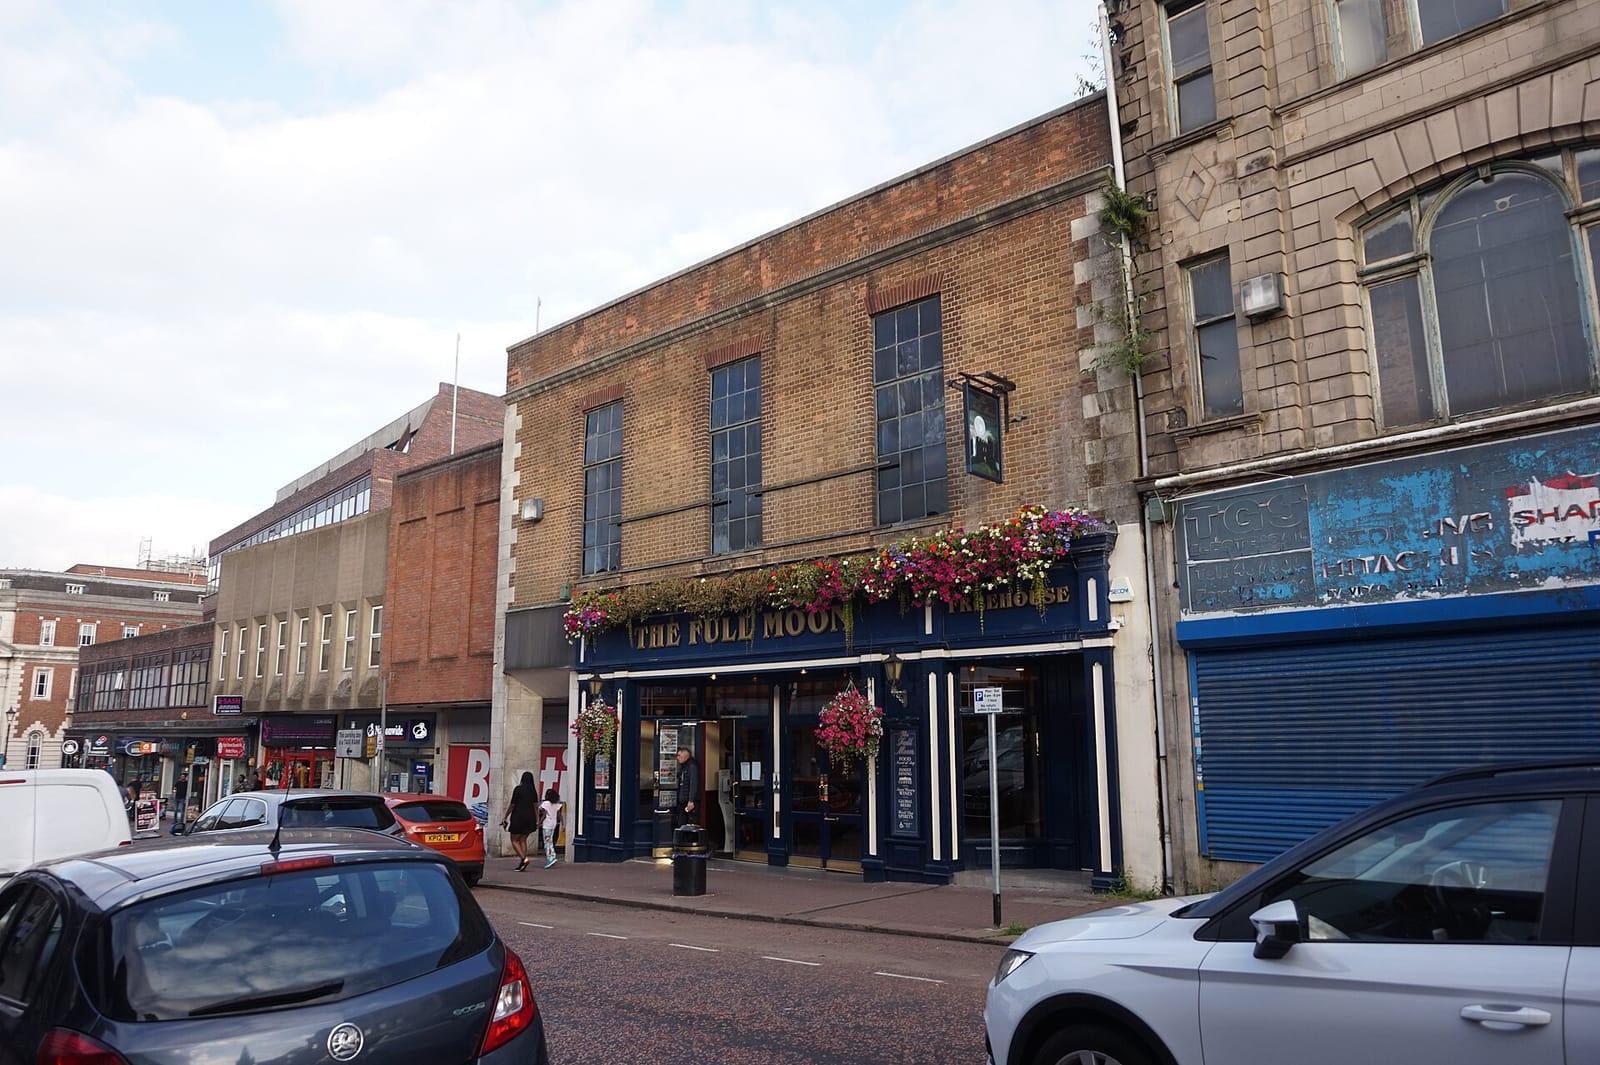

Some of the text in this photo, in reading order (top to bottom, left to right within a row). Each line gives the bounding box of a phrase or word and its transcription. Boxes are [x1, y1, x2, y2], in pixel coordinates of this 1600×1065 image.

[634, 604, 847, 649] THE FULL MOON
[375, 724, 404, 736] Naonwide
